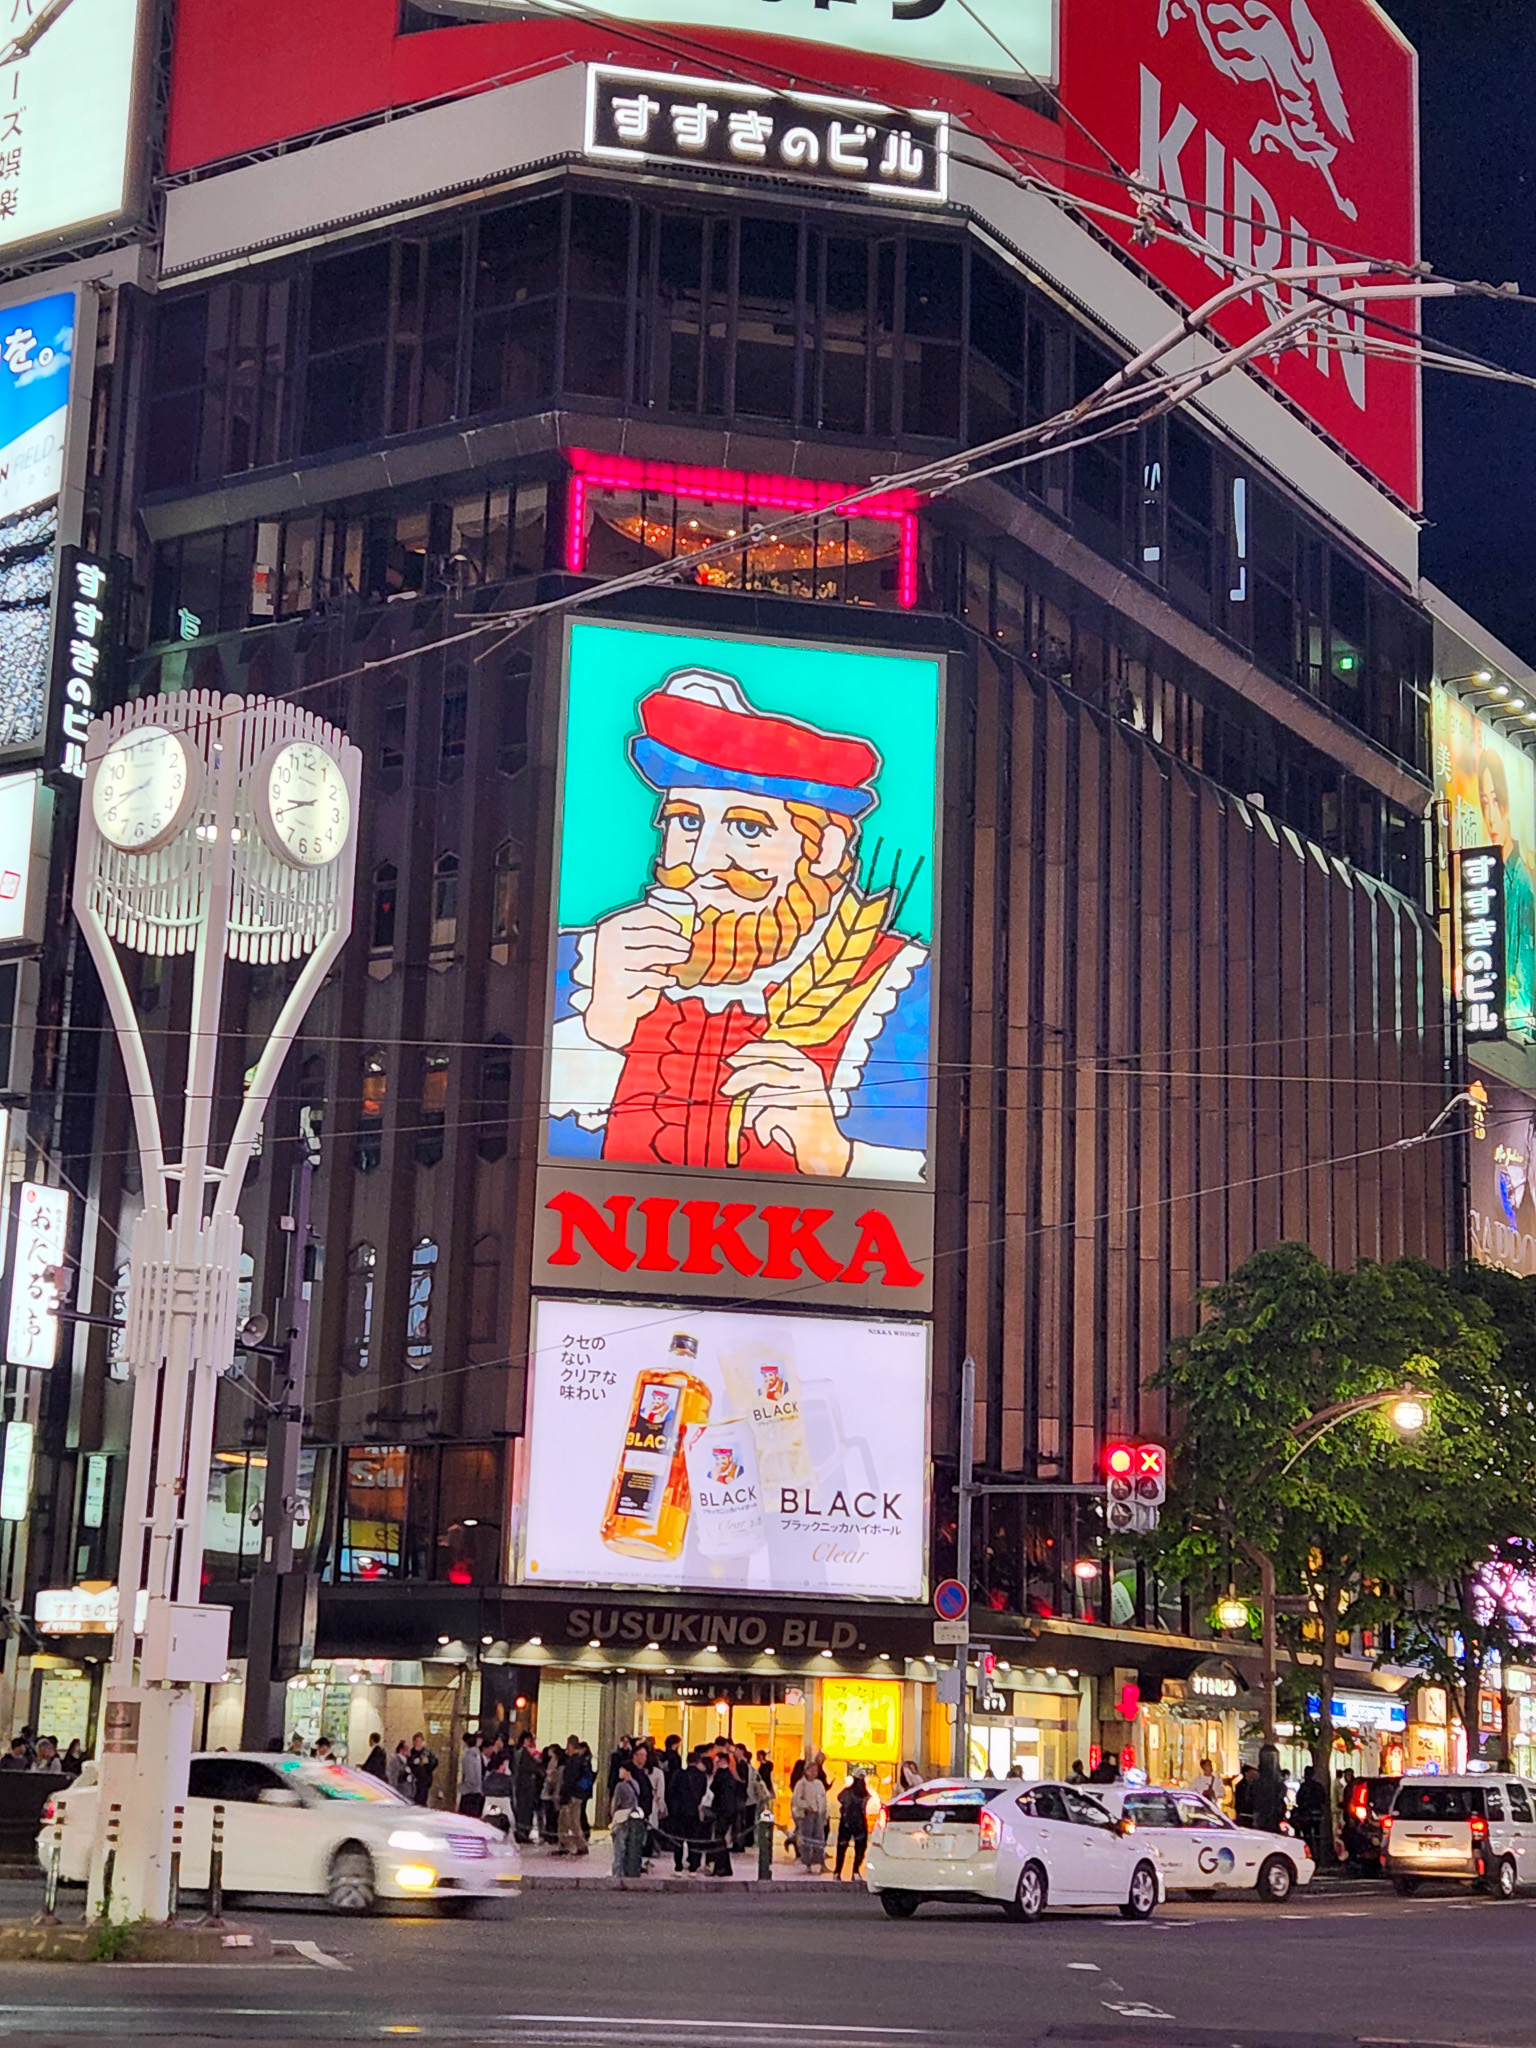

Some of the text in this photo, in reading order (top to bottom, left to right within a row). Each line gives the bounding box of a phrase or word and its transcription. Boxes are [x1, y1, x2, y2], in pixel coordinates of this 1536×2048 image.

[611, 93, 924, 177] すすきのビル
[1138, 62, 1365, 412] KIRIN
[60, 561, 106, 779] すすきのビル
[1462, 855, 1498, 1032] すすきのビル
[544, 1190, 924, 1287] NIKKA
[562, 1334, 606, 1350] クセの
[868, 1328, 892, 1336] NIKKA
[561, 1351, 591, 1366] ない
[560, 1368, 617, 1385] クリアな
[560, 1385, 606, 1400] 味わい
[753, 1401, 799, 1421] BLACK
[625, 1432, 677, 1452] BLACK
[700, 1485, 757, 1507] BLACK
[780, 1487, 903, 1521] BLACK
[780, 1519, 902, 1536] ブラックニッカハイボール
[812, 1541, 869, 1564] Clear
[566, 1608, 867, 1650] SUSUKINO BLD.
